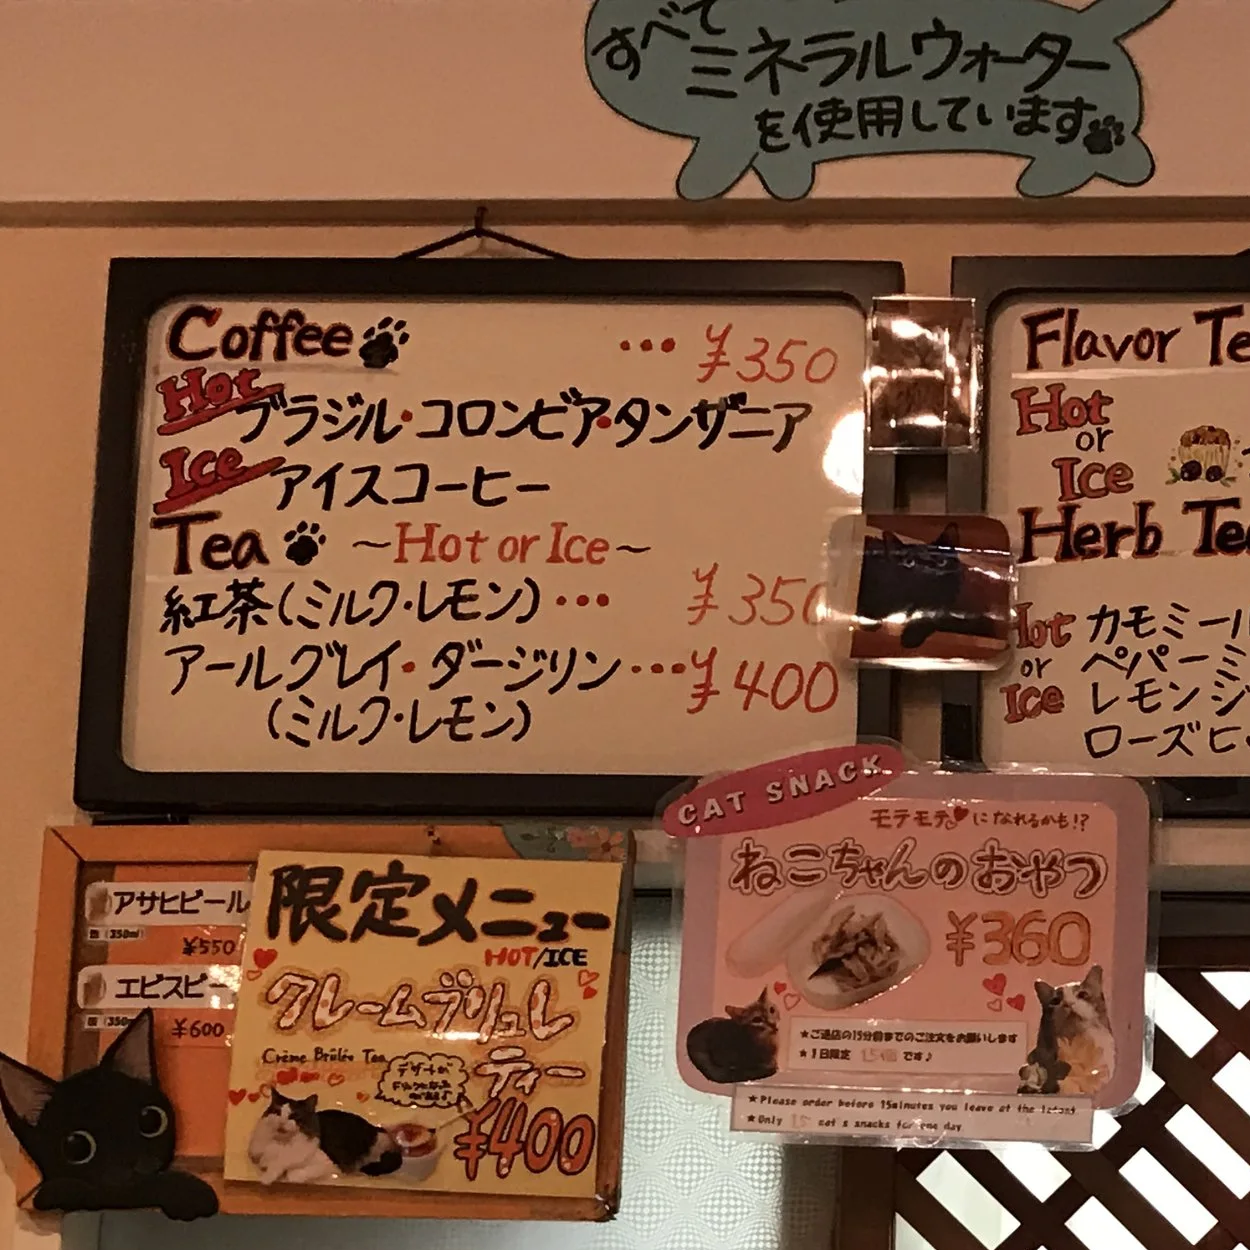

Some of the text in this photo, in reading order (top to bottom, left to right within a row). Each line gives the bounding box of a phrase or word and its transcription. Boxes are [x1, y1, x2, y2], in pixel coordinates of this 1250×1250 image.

[591, 0, 726, 80] すべて
[686, 18, 1110, 97] ミネラルウォーター
[755, 96, 1097, 153] を使用しています
[166, 305, 840, 383] Coffee ¥350
[1020, 308, 1180, 372] Flavor
[158, 368, 266, 420] Hot
[1011, 382, 1115, 436] Hot
[1075, 425, 1115, 455] or
[160, 446, 247, 499] Ice
[270, 461, 551, 509] アイスコーヒー
[1051, 455, 1135, 502] Ice
[151, 511, 269, 575] Tea
[499, 537, 538, 564] or
[1018, 502, 1164, 564] Herb
[686, 646, 840, 714] ¥400
[1020, 656, 1053, 680] or
[1000, 684, 1066, 724] Ice
[678, 754, 884, 827] CAT SNACK
[869, 806, 946, 831] モテモテ
[729, 836, 1109, 899] ねこちゃんのおやつ
[113, 888, 251, 915] アサヒビール
[265, 859, 611, 946] 限定メニュー
[182, 936, 236, 956] ¥550
[945, 908, 1092, 968] ¥360
[115, 972, 236, 1000] エビスビー
[266, 968, 576, 1045] クレームブリュレ
[171, 1017, 225, 1039] ¥600
[473, 1045, 586, 1099] ティー
[803, 1097, 834, 1110] order
[939, 1101, 959, 1114] you
[964, 1101, 994, 1114] leave
[999, 1102, 1012, 1114] at
[853, 1117, 891, 1130] snacks
[943, 1121, 963, 1135] day
[454, 1099, 597, 1182] ¥400
